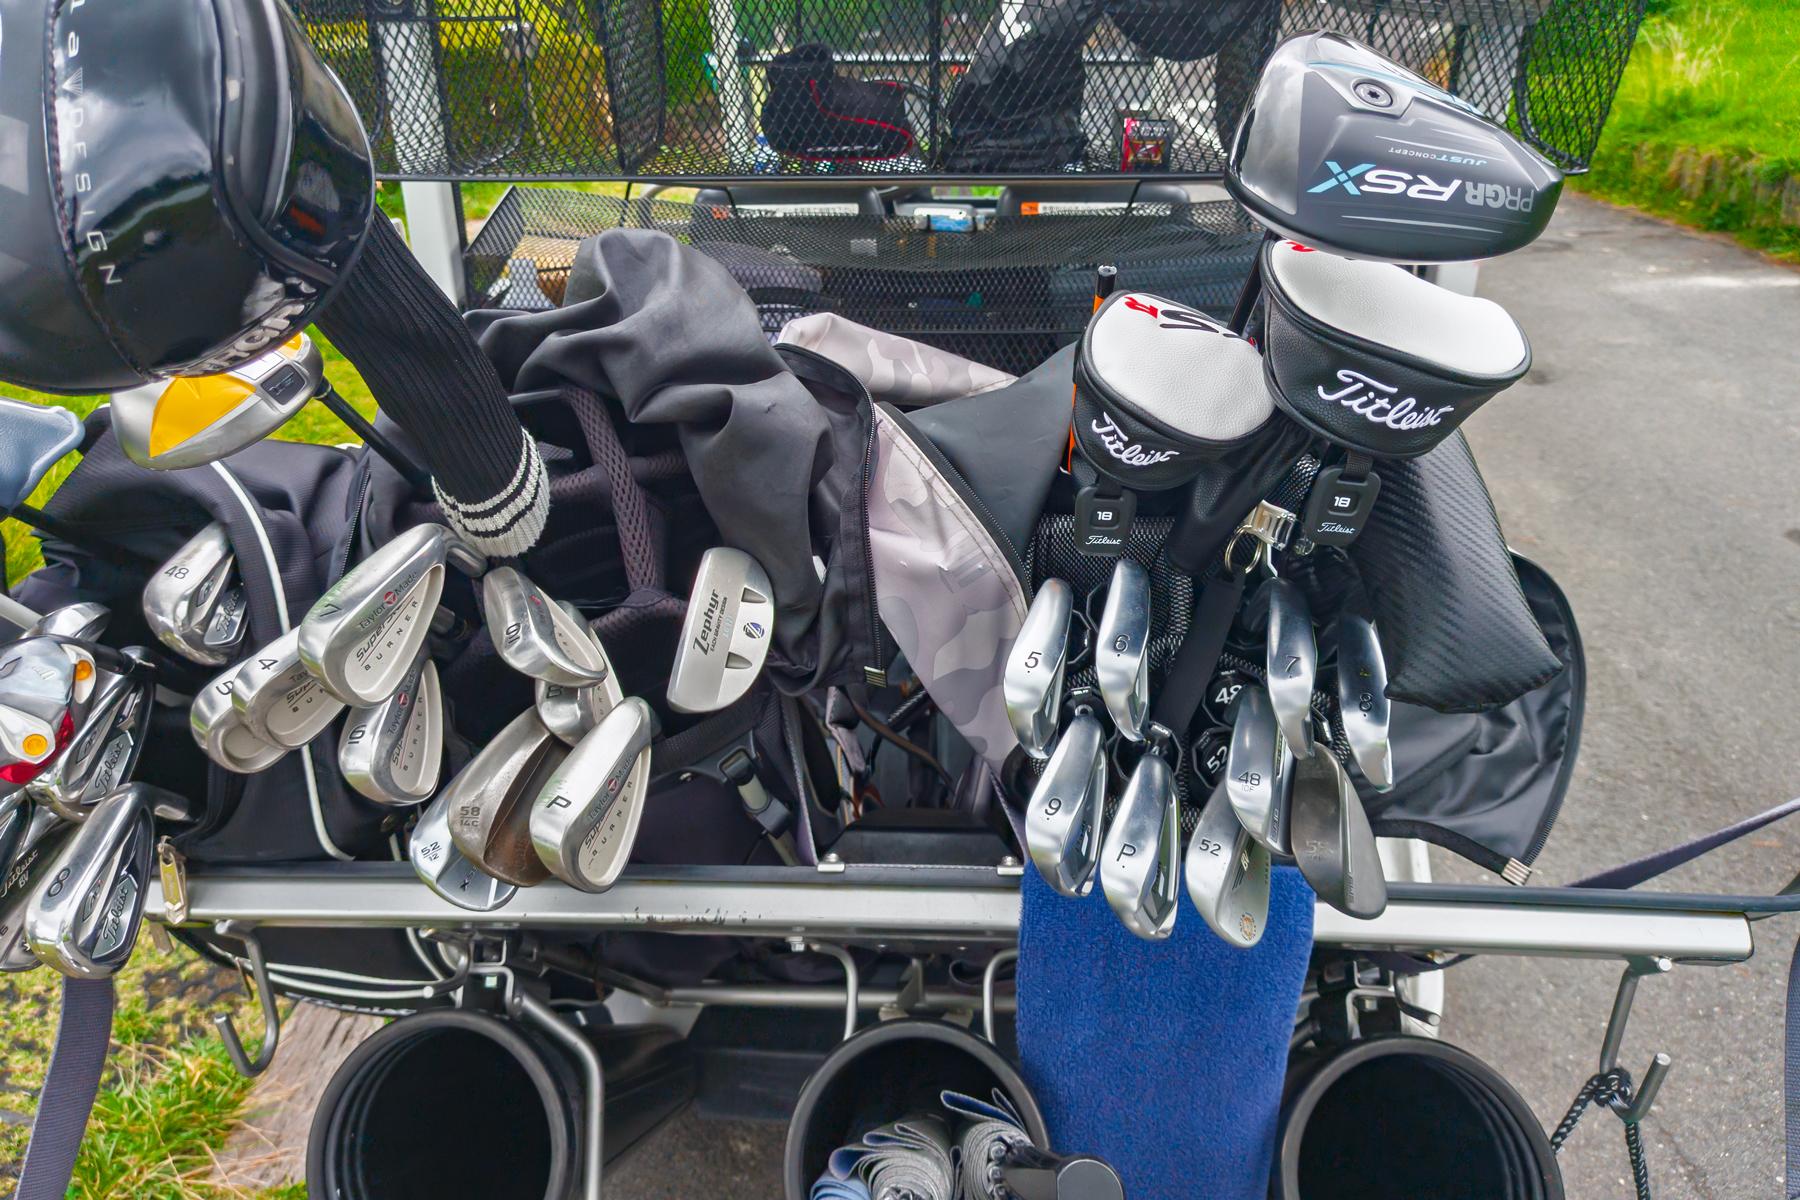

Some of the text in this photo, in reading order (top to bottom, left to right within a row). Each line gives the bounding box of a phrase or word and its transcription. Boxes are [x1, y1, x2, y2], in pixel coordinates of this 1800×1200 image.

[1307, 161, 1534, 213] PRGR RSX
[1317, 368, 1455, 431] Titleist
[1091, 411, 1180, 467] Titleist
[1333, 495, 1351, 508] 18
[1096, 510, 1113, 521] 18
[1317, 521, 1356, 535] Titleist
[1085, 534, 1122, 547] Titleist
[163, 564, 190, 581] 48
[692, 588, 720, 656] Zephyr
[364, 600, 418, 672] BURNER
[1113, 634, 1130, 654] 6
[258, 657, 278, 671] 4
[1024, 651, 1042, 670] 5
[1283, 656, 1300, 673] 7
[1359, 694, 1372, 712] 8
[95, 741, 123, 797] Titleist
[1237, 772, 1262, 787] 48
[459, 805, 480, 817] 58
[546, 794, 572, 812] P
[1044, 798, 1062, 816] 9
[420, 840, 441, 858] 52
[1116, 845, 1137, 863] P
[1199, 838, 1221, 858] 52
[102, 885, 129, 947] Titleist
